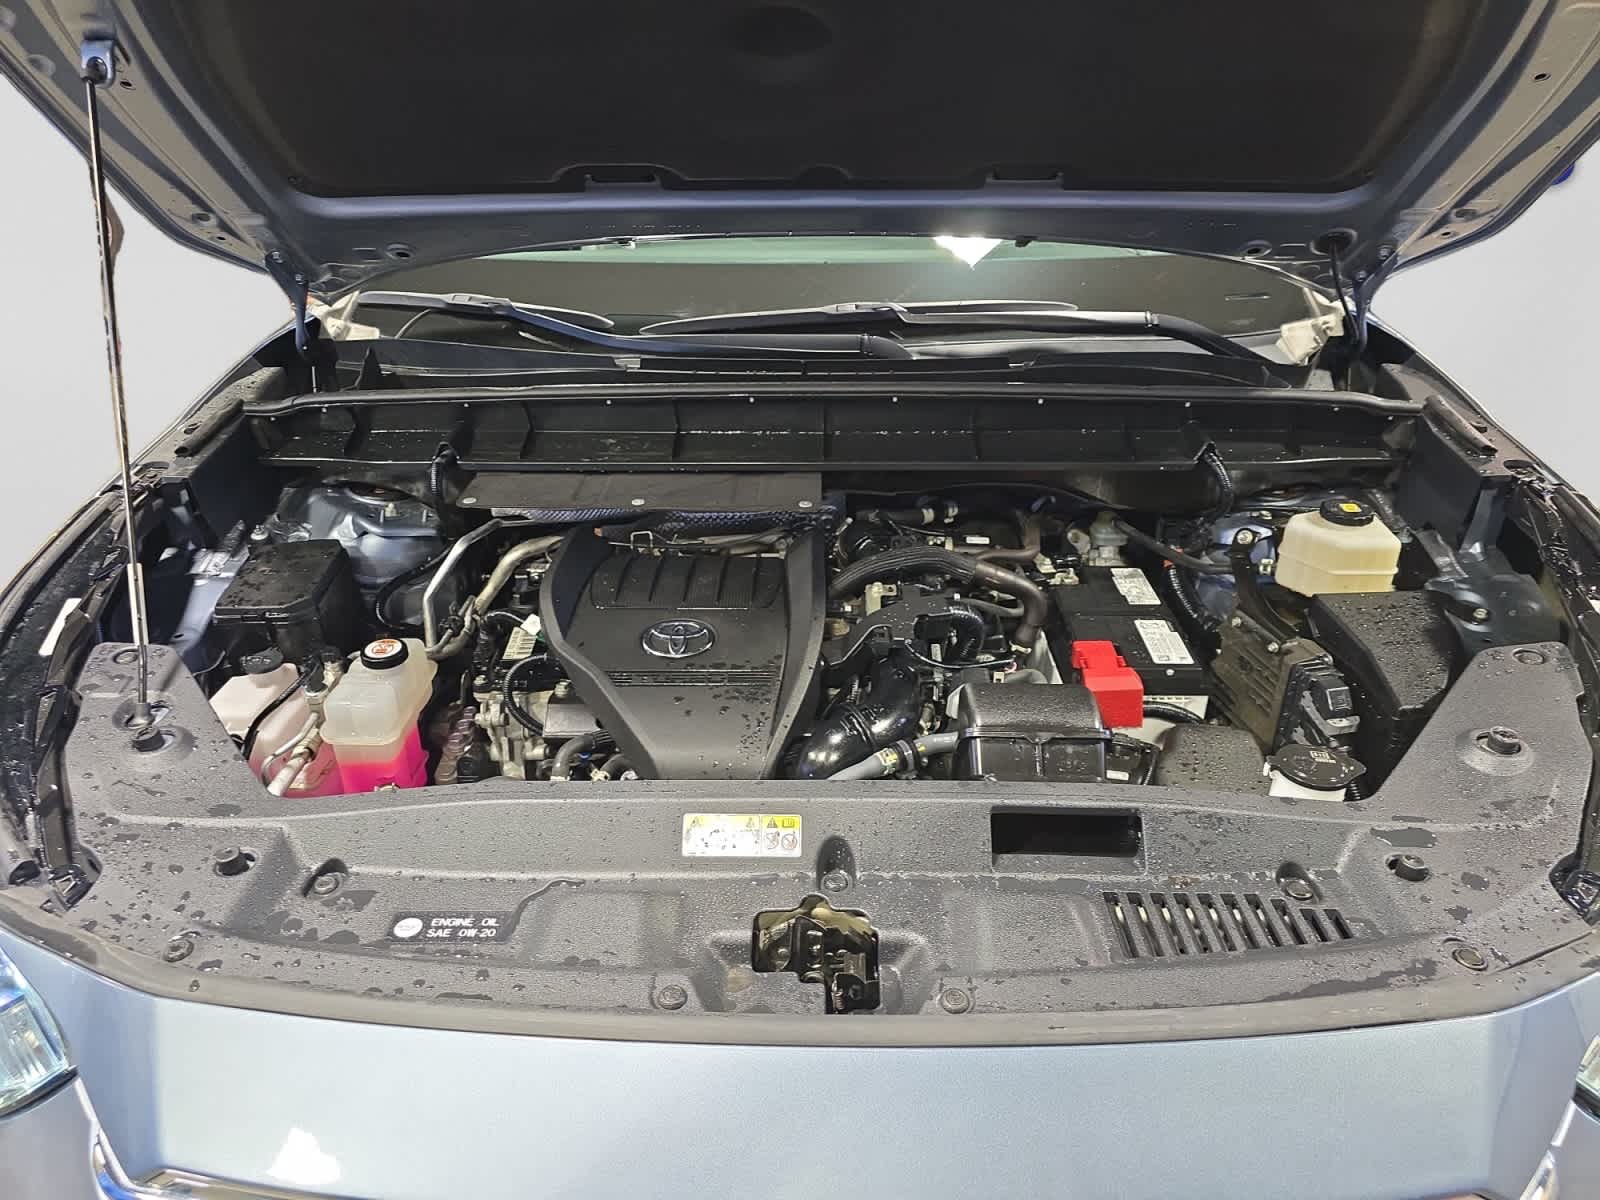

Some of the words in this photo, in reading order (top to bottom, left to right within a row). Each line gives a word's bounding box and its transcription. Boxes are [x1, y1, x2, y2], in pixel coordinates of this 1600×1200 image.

[431, 917, 475, 927] ENGINE
[481, 917, 500, 927] OIL
[426, 928, 453, 938] SAE
[459, 928, 497, 938] 0W-20
